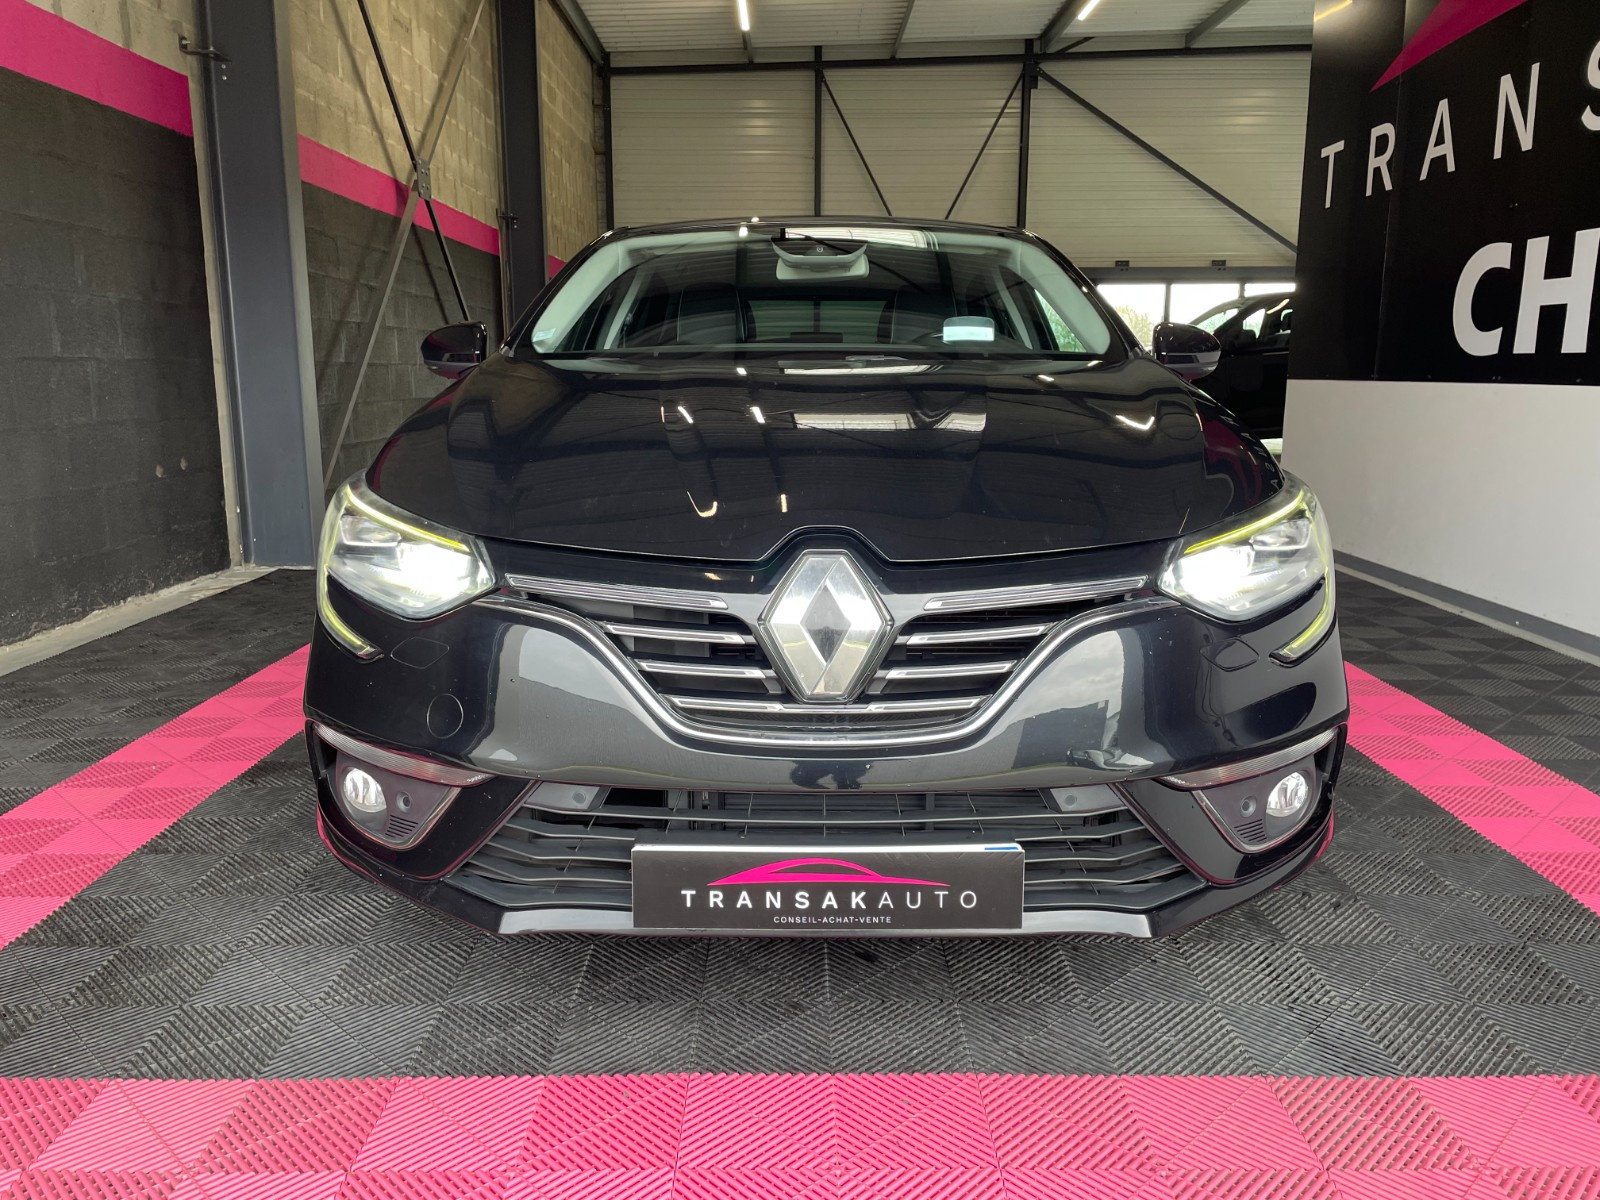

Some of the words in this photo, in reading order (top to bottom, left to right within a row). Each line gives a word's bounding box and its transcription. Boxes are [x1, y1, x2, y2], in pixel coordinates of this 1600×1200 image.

[1453, 228, 1600, 356] CH
[681, 890, 977, 909] TRANSAKAUTO
[773, 916, 892, 924] CONSEIL-ACHAT-VENTE
